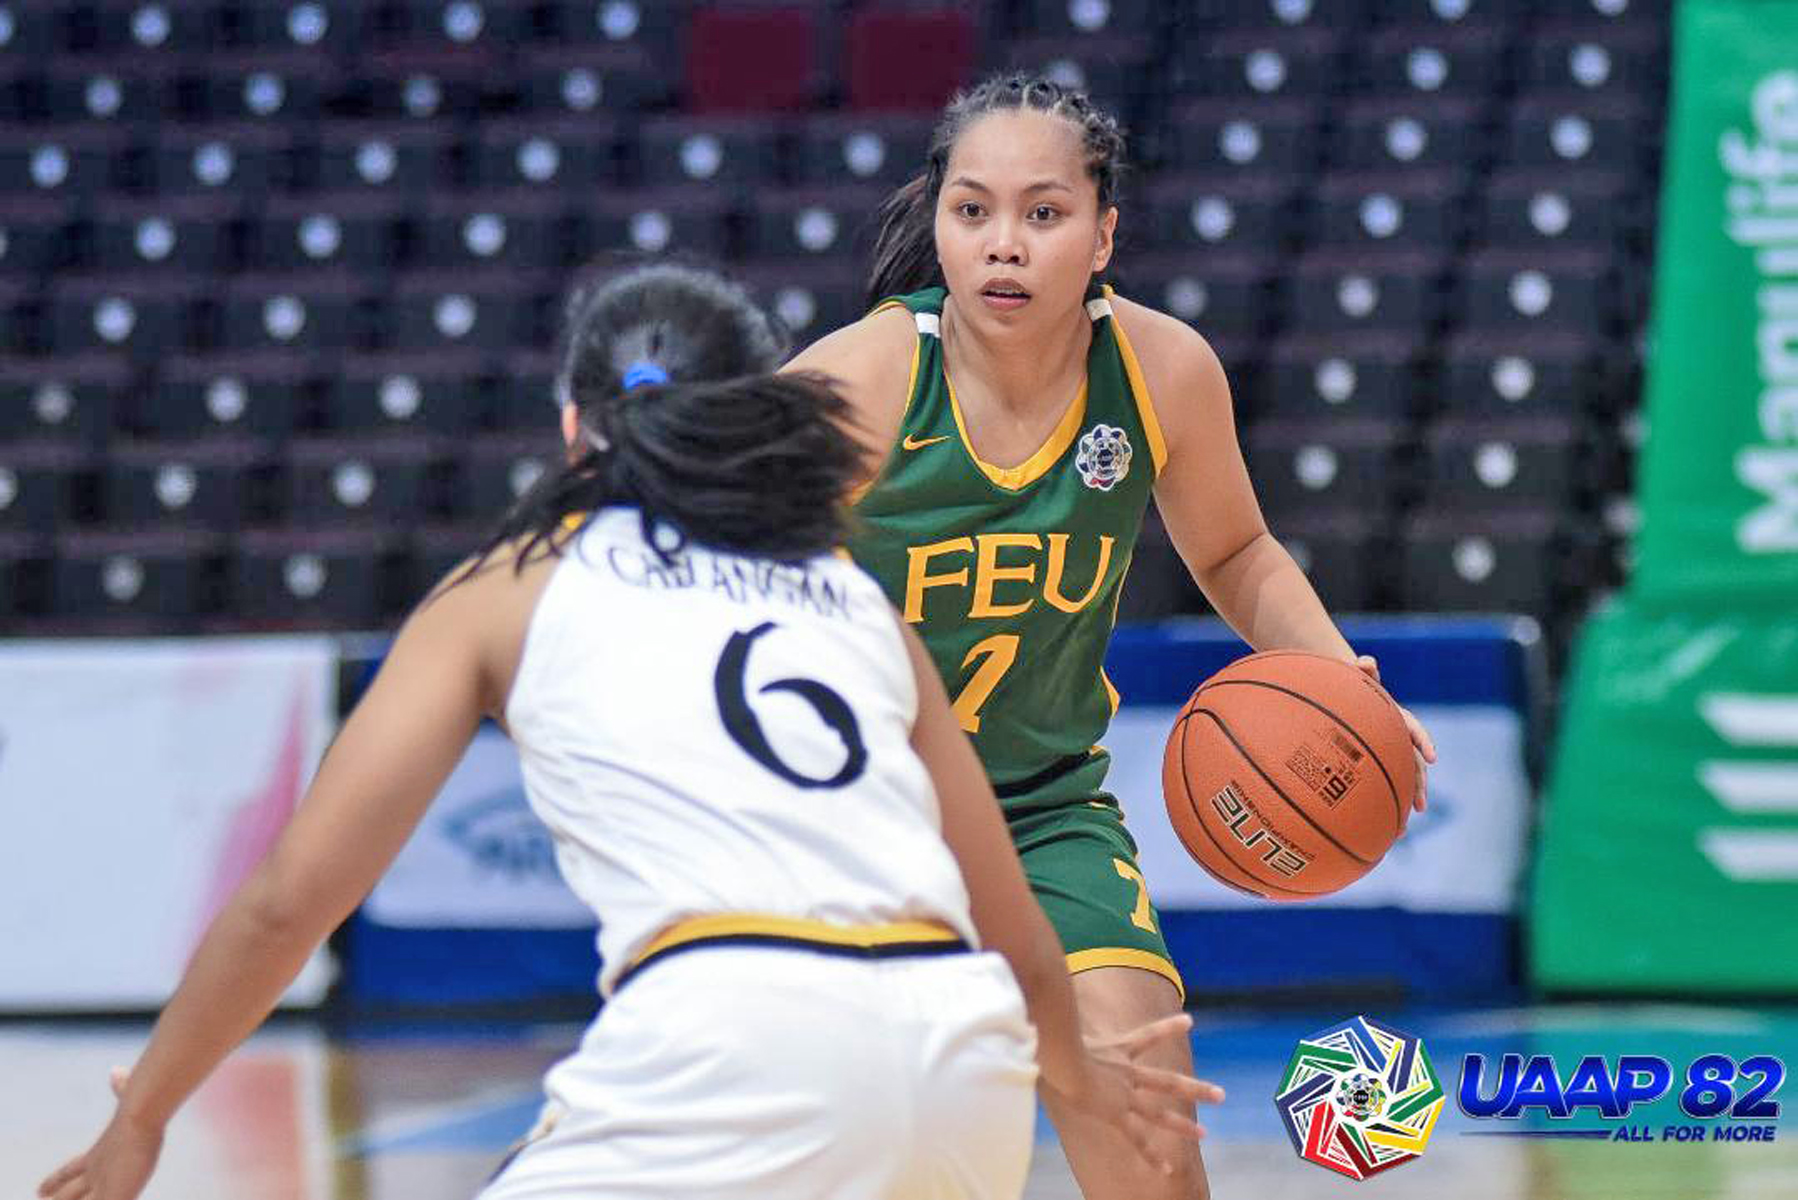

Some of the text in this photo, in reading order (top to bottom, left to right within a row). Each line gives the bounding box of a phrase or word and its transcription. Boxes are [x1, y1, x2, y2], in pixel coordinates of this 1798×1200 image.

[904, 533, 1115, 623] FEU
[714, 621, 869, 790] 6
[1211, 785, 1307, 878] ELITE
[1113, 858, 1157, 933] 7
